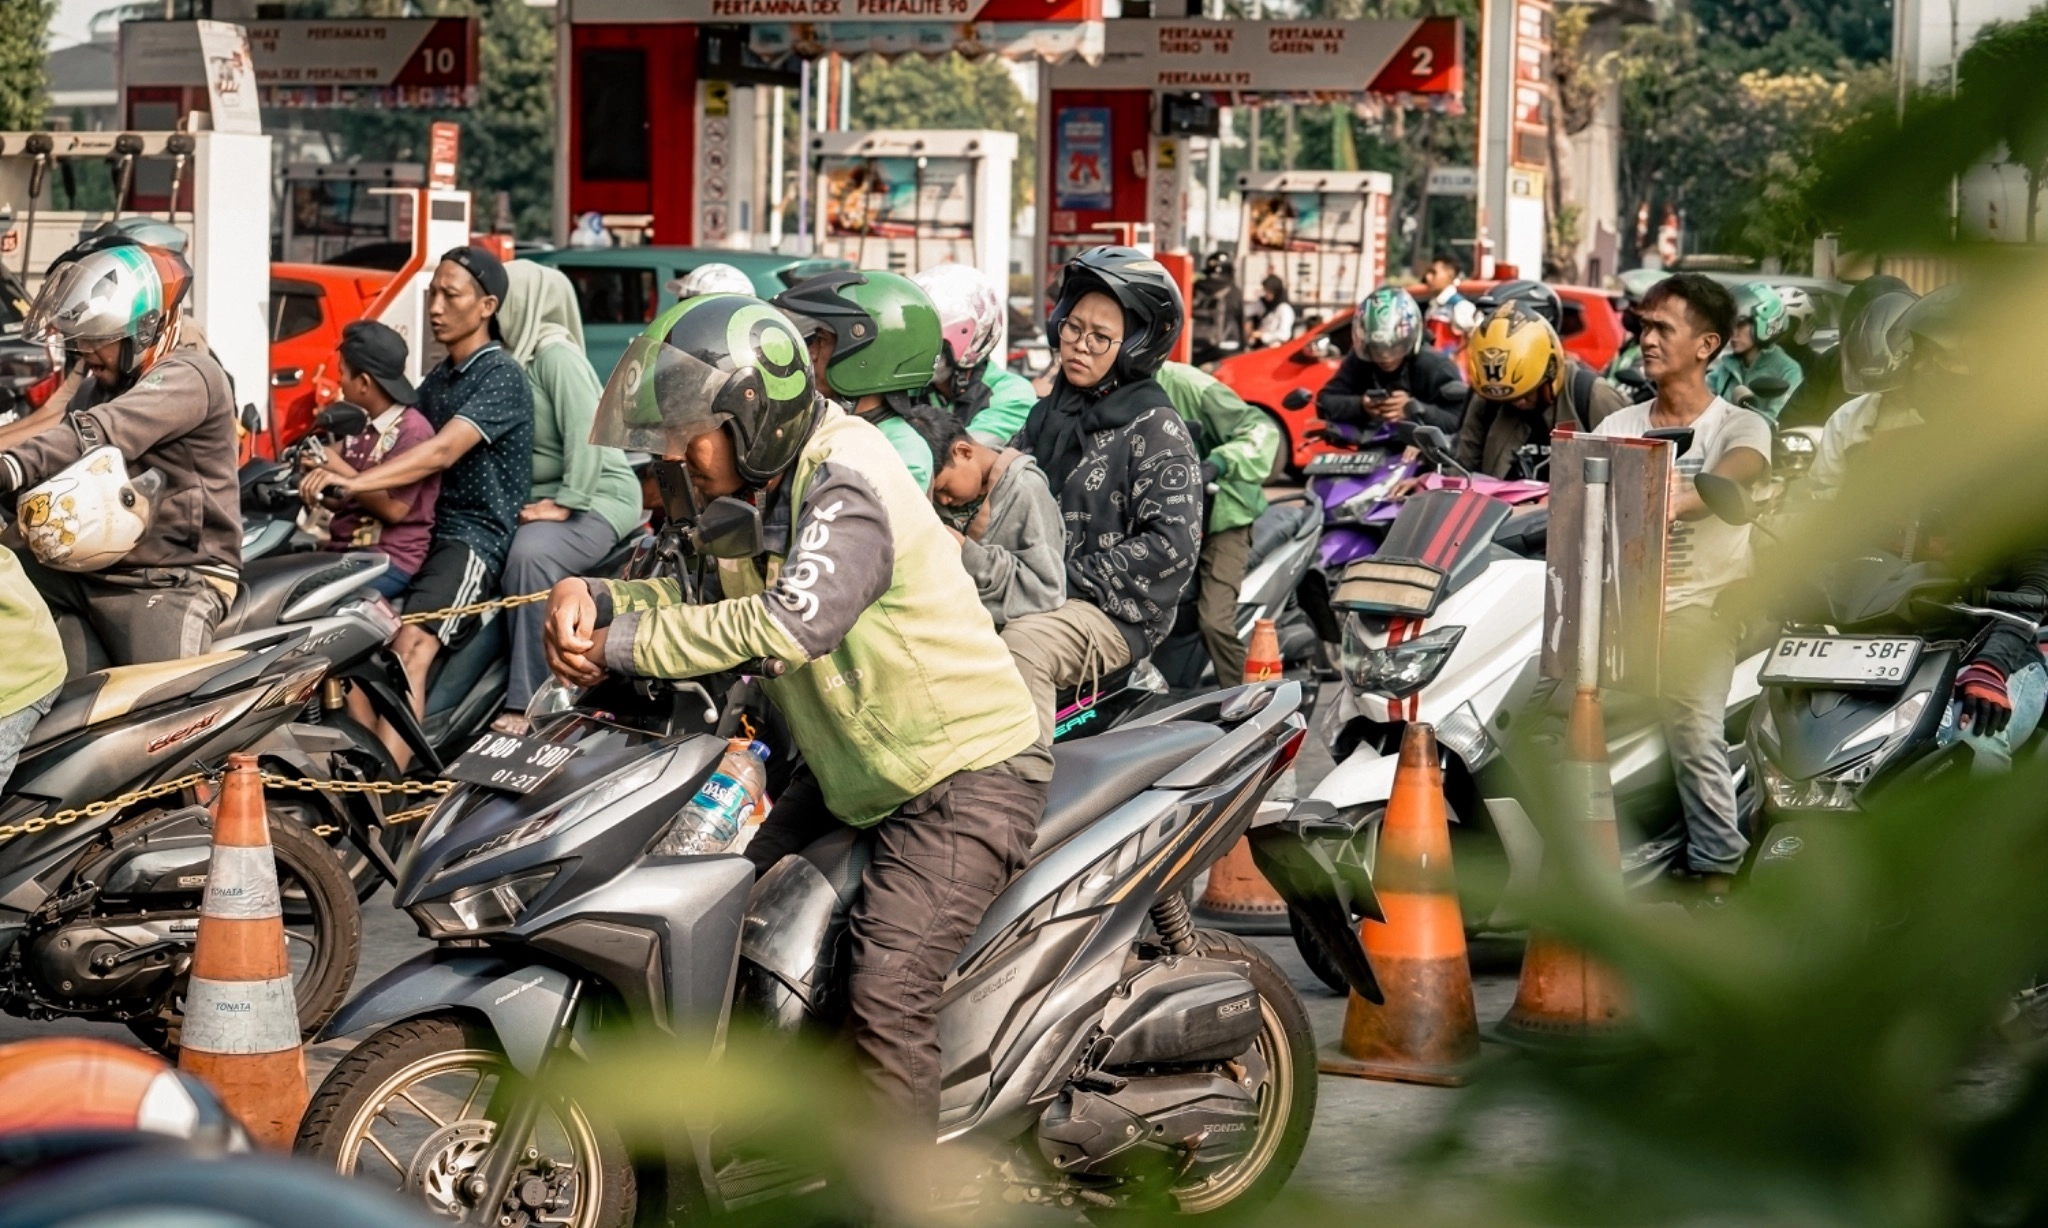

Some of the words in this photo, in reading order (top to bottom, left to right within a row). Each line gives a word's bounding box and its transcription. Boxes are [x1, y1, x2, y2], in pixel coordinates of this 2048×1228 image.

[857, 0, 945, 15] PERTALITE
[948, 0, 968, 14] 90
[1158, 27, 1234, 41] PERTAMAX
[1268, 27, 1345, 40] PERTAMAX
[422, 48, 455, 74] 10
[1411, 46, 1434, 75] 2
[1158, 72, 1232, 85] PERTAMAX
[777, 500, 844, 622] gojek
[823, 668, 864, 693] Jago
[1053, 709, 1097, 738] EAR
[211, 888, 244, 897] TONATA
[215, 1002, 251, 1012] TONATA
[1203, 1122, 1247, 1133] HONDA
